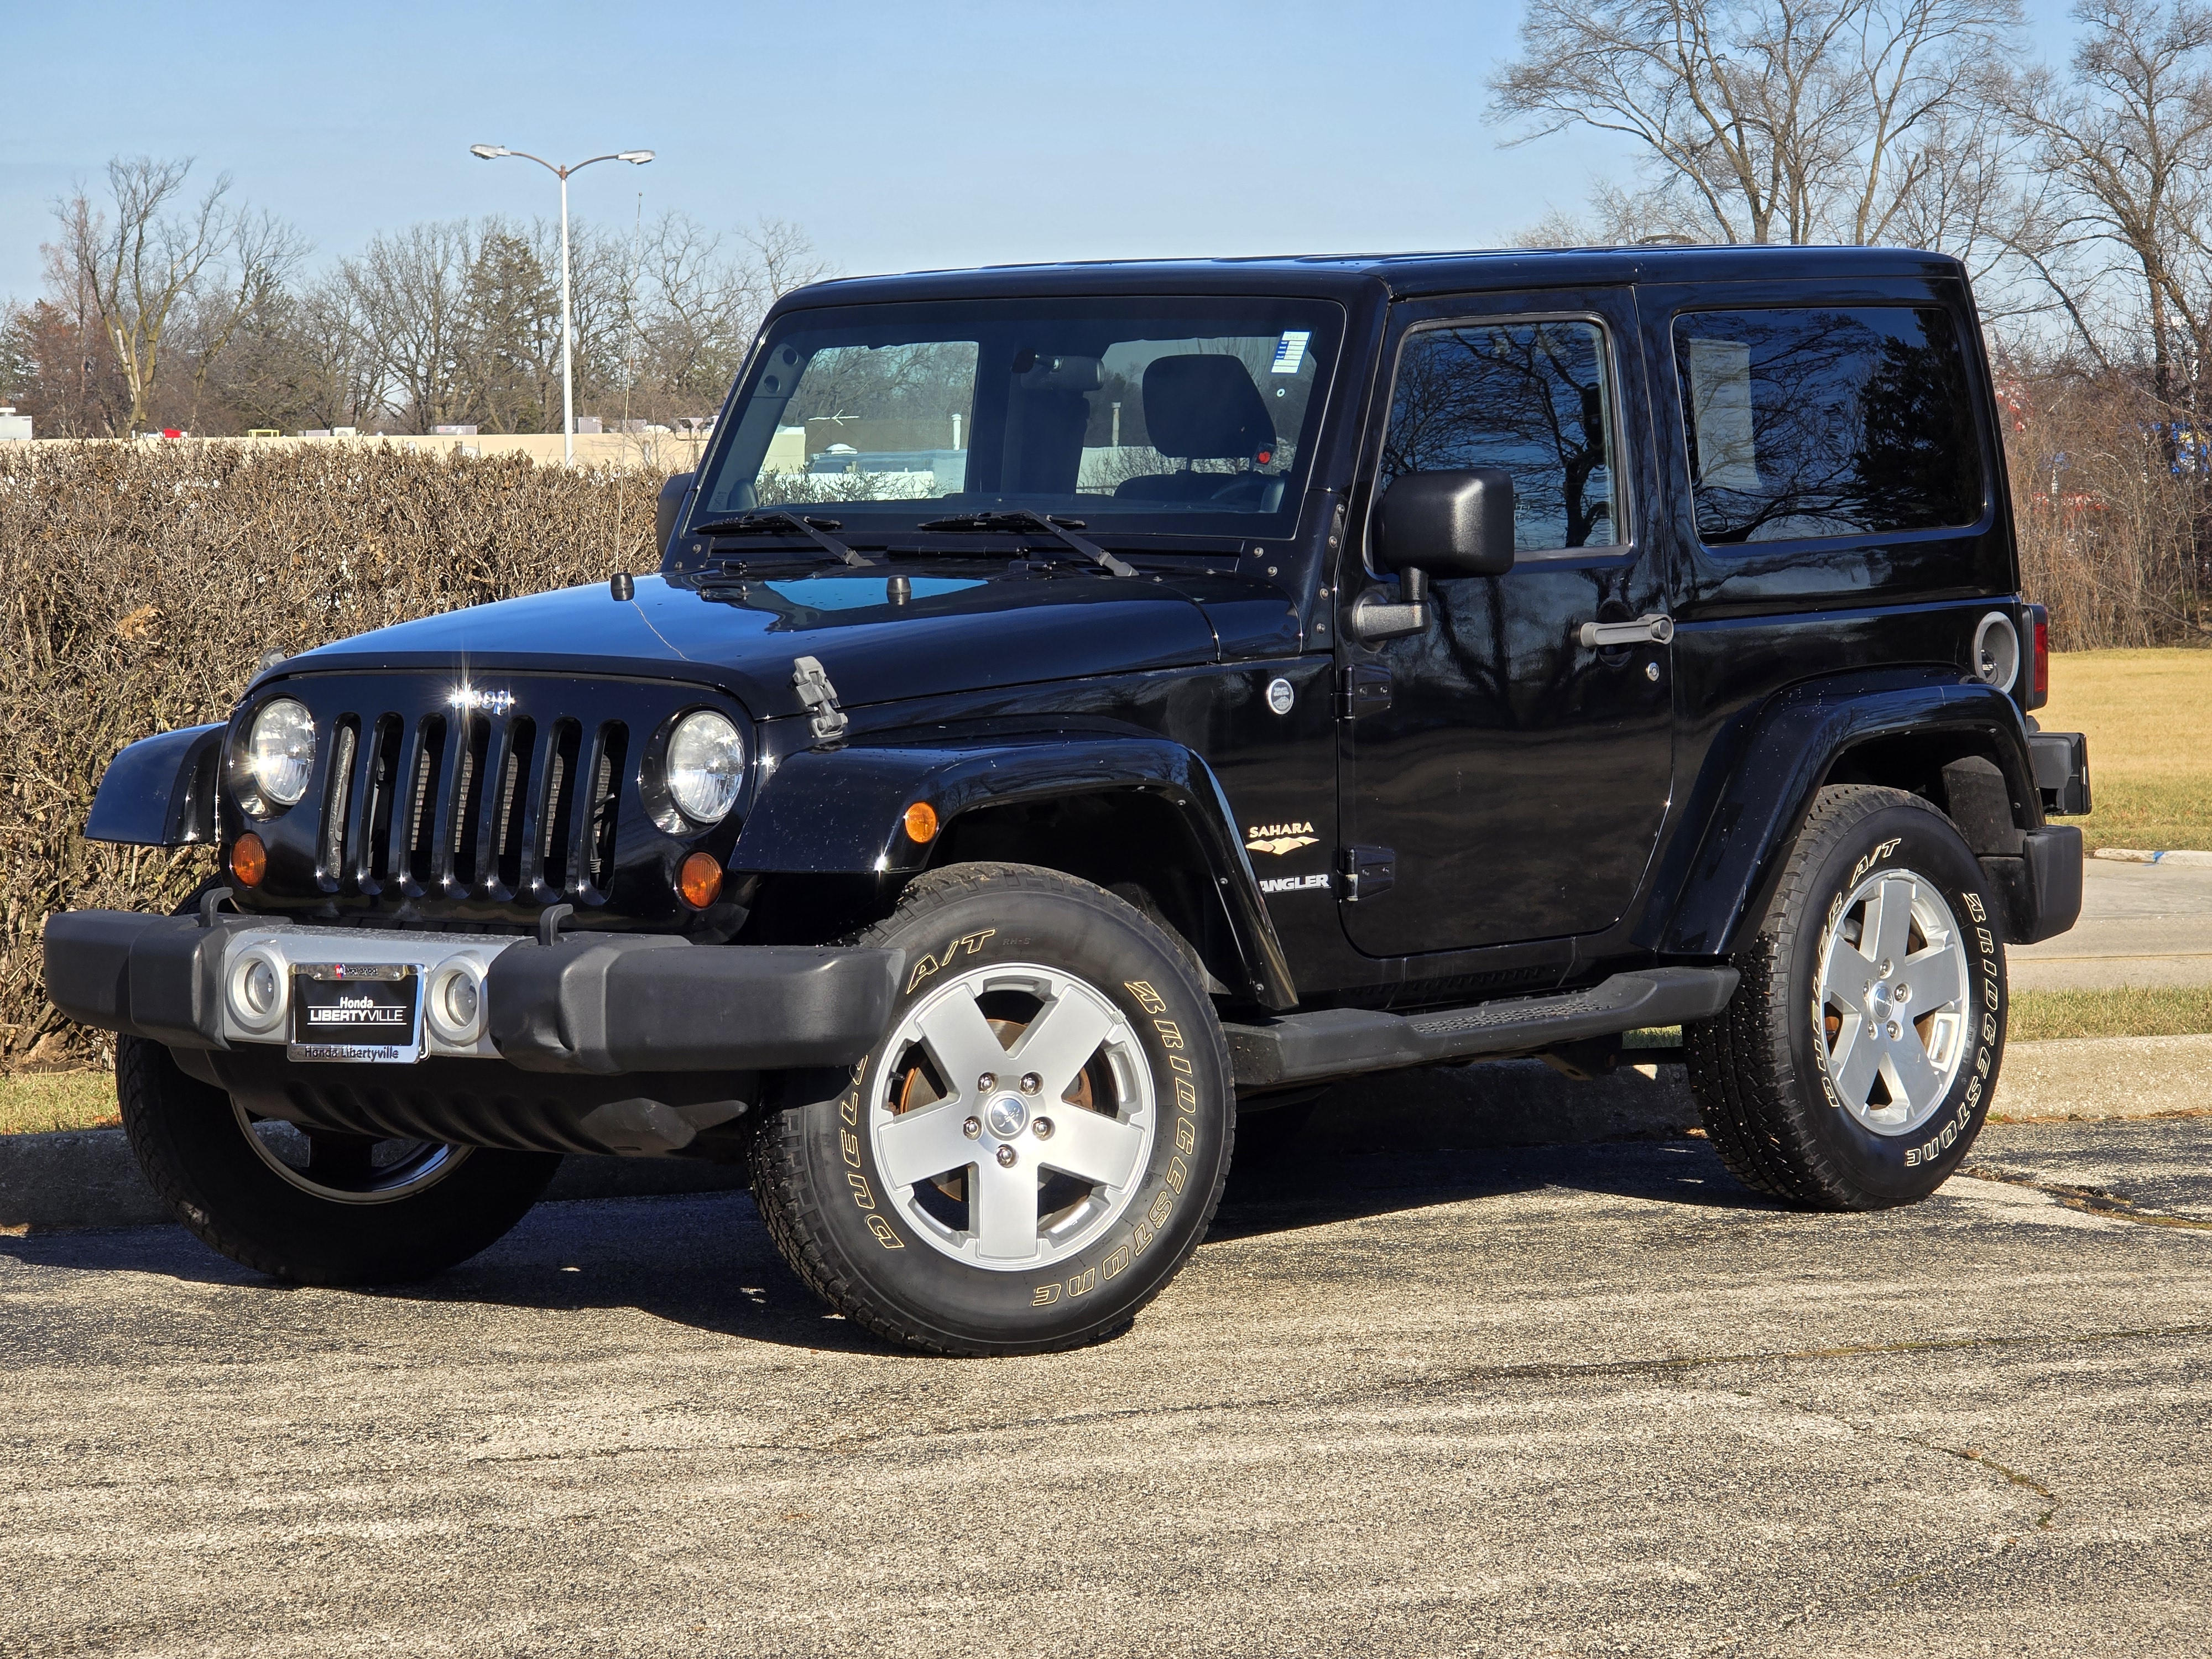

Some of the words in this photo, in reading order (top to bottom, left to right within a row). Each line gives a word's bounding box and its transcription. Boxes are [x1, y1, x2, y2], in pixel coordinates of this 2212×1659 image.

[1249, 821, 1314, 838] SAHARA
[1849, 838, 1902, 888] A/T
[1259, 874, 1331, 893] ANGLER
[906, 928, 997, 994] A/T
[310, 1010, 403, 1021] LIBERTYVILLE
[340, 996, 373, 1009] Honda
[1906, 893, 1998, 1167] BRIDGESTONE
[305, 1046, 338, 1058] Honda
[341, 1046, 399, 1062] Libertyville
[840, 1055, 905, 1249] DUEL
[1032, 981, 1196, 1306] BRIDGESTONE
